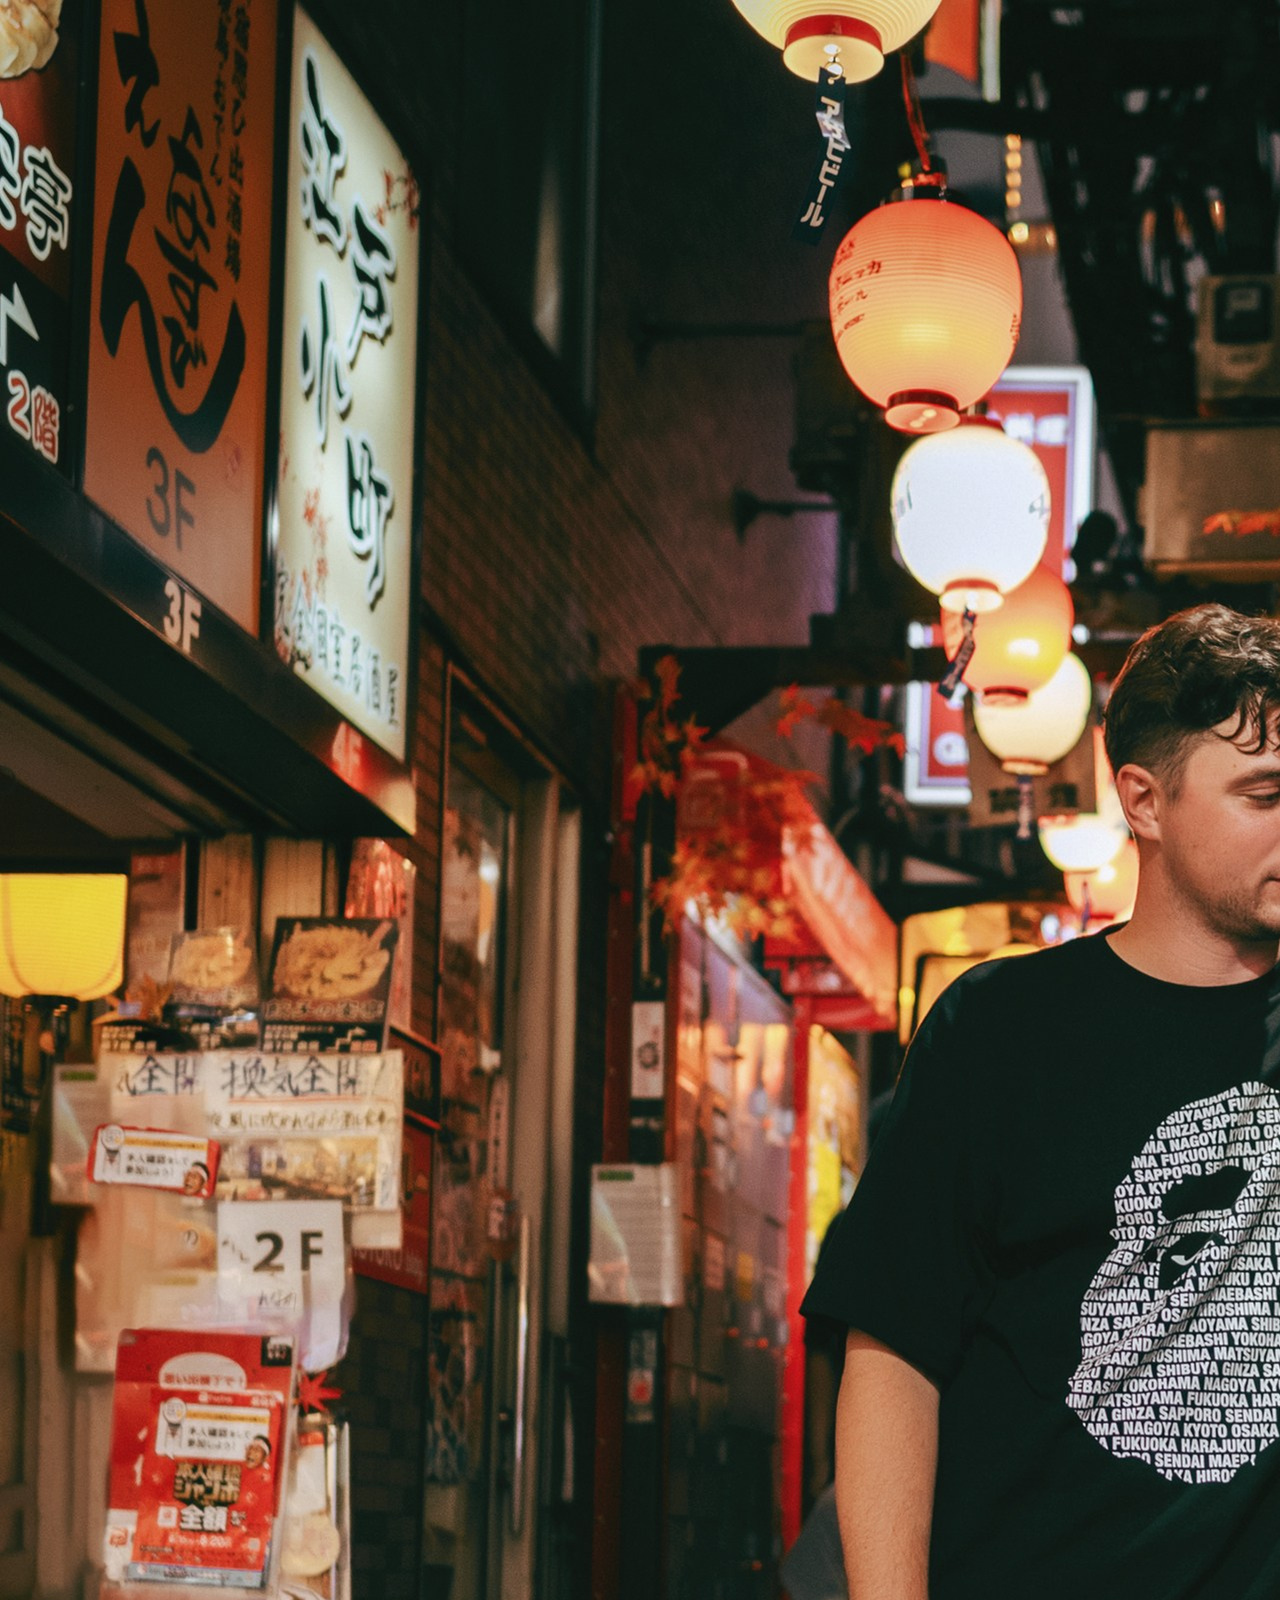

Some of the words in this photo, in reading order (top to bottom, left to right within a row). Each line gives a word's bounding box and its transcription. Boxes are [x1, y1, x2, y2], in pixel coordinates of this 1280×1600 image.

[8, 369, 60, 464] 2階
[145, 446, 197, 553] 3F
[163, 579, 201, 656] 3F
[1156, 1122, 1201, 1141] GINZA
[1169, 1130, 1228, 1153] NAGOYA
[1160, 1145, 1225, 1167] FUKUOKA
[1133, 1162, 1202, 1184] SAPPORO
[1080, 1300, 1139, 1317] SUYAMA
[1188, 1316, 1249, 1332] AOYAMA
[1156, 1360, 1219, 1379] SHIBUYA
[1222, 1361, 1261, 1379] GINZA
[1123, 1376, 1201, 1394] YOKOHAMA
[1204, 1376, 1258, 1394] NAGOYA
[1096, 1390, 1185, 1408] MATSUYAMA
[1186, 1391, 1250, 1408] FUKUOKA
[1111, 1406, 1157, 1422] GINZA
[1158, 1405, 1222, 1423] SAPPORO
[1224, 1407, 1278, 1423] SENDAI
[1122, 1420, 1182, 1438] NAGOYA
[1182, 1421, 1229, 1439] KYOTO
[1230, 1422, 1280, 1439] OSAKA
[1111, 1435, 1179, 1452] FUKUOKA
[1180, 1437, 1257, 1454] HARAJUKU
[1154, 1452, 1206, 1469] SENDAI
[180, 1504, 229, 1534] 全額
